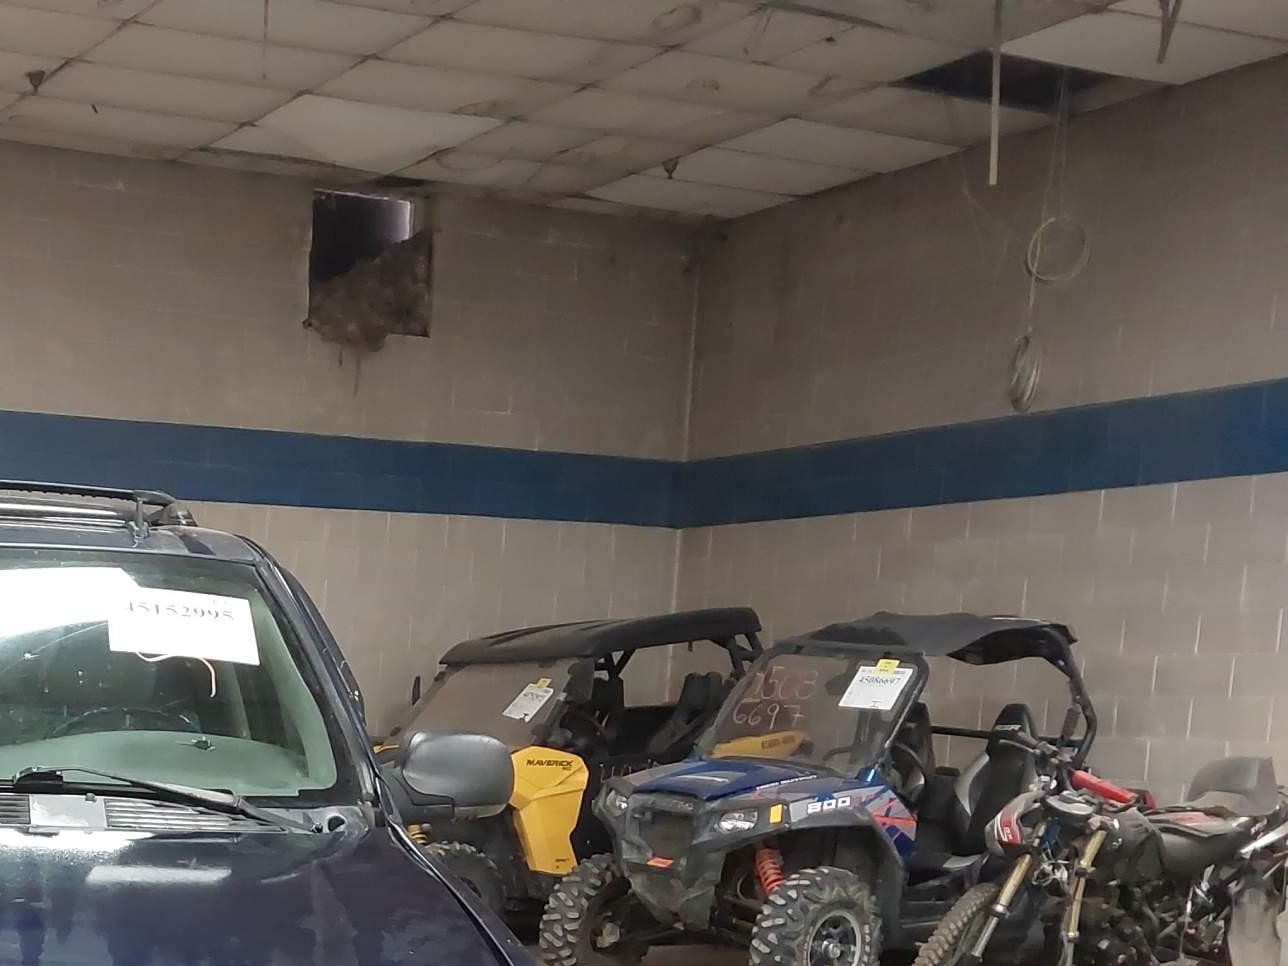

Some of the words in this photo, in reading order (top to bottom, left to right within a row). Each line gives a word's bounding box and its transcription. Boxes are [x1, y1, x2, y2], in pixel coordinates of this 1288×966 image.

[732, 702, 806, 730] 6697
[526, 759, 573, 767] MAVERICK
[807, 796, 852, 815] 800
